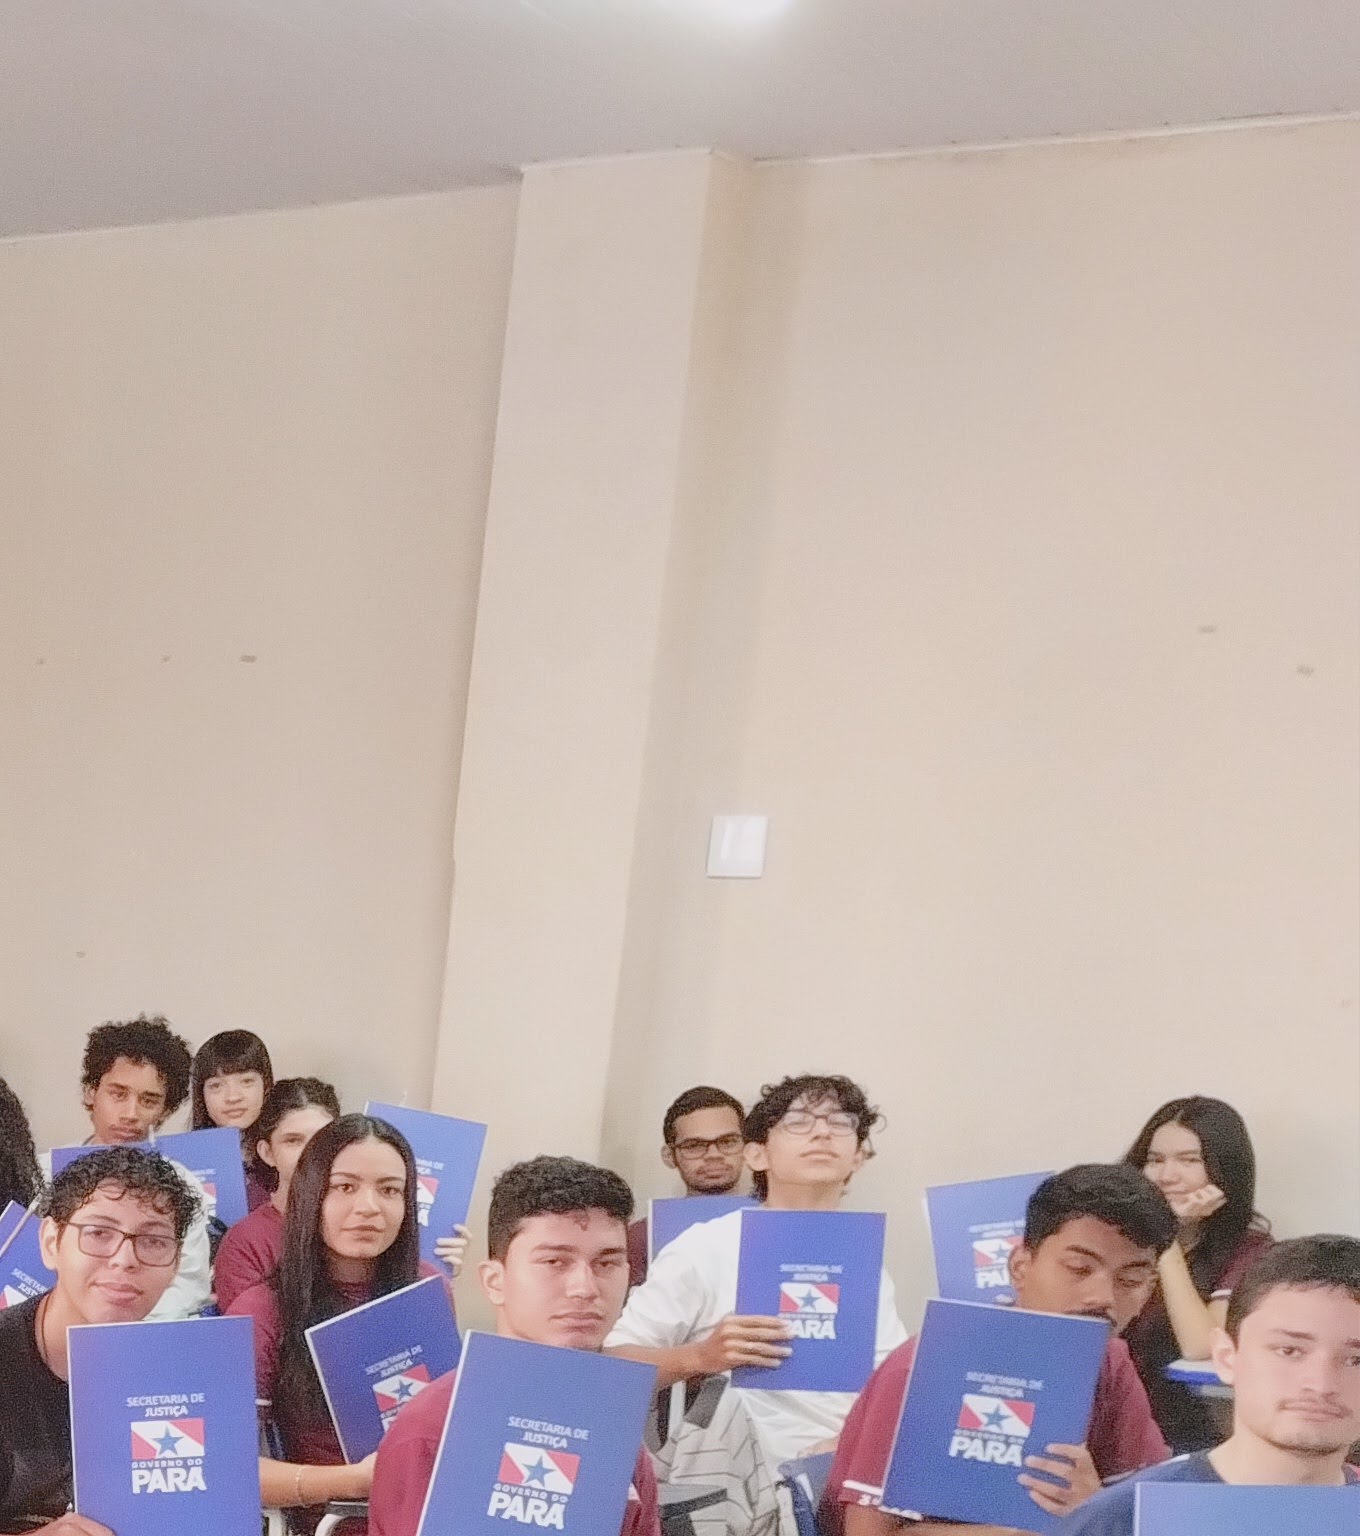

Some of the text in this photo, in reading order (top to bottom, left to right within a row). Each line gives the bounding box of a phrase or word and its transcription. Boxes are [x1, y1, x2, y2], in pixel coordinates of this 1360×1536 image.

[126, 1393, 205, 1408] SECRETARIA DE
[145, 1406, 188, 1418] JUSTIÇA
[508, 1416, 589, 1440] SECRETARIA DE
[523, 1431, 567, 1449] JUSTIÇA
